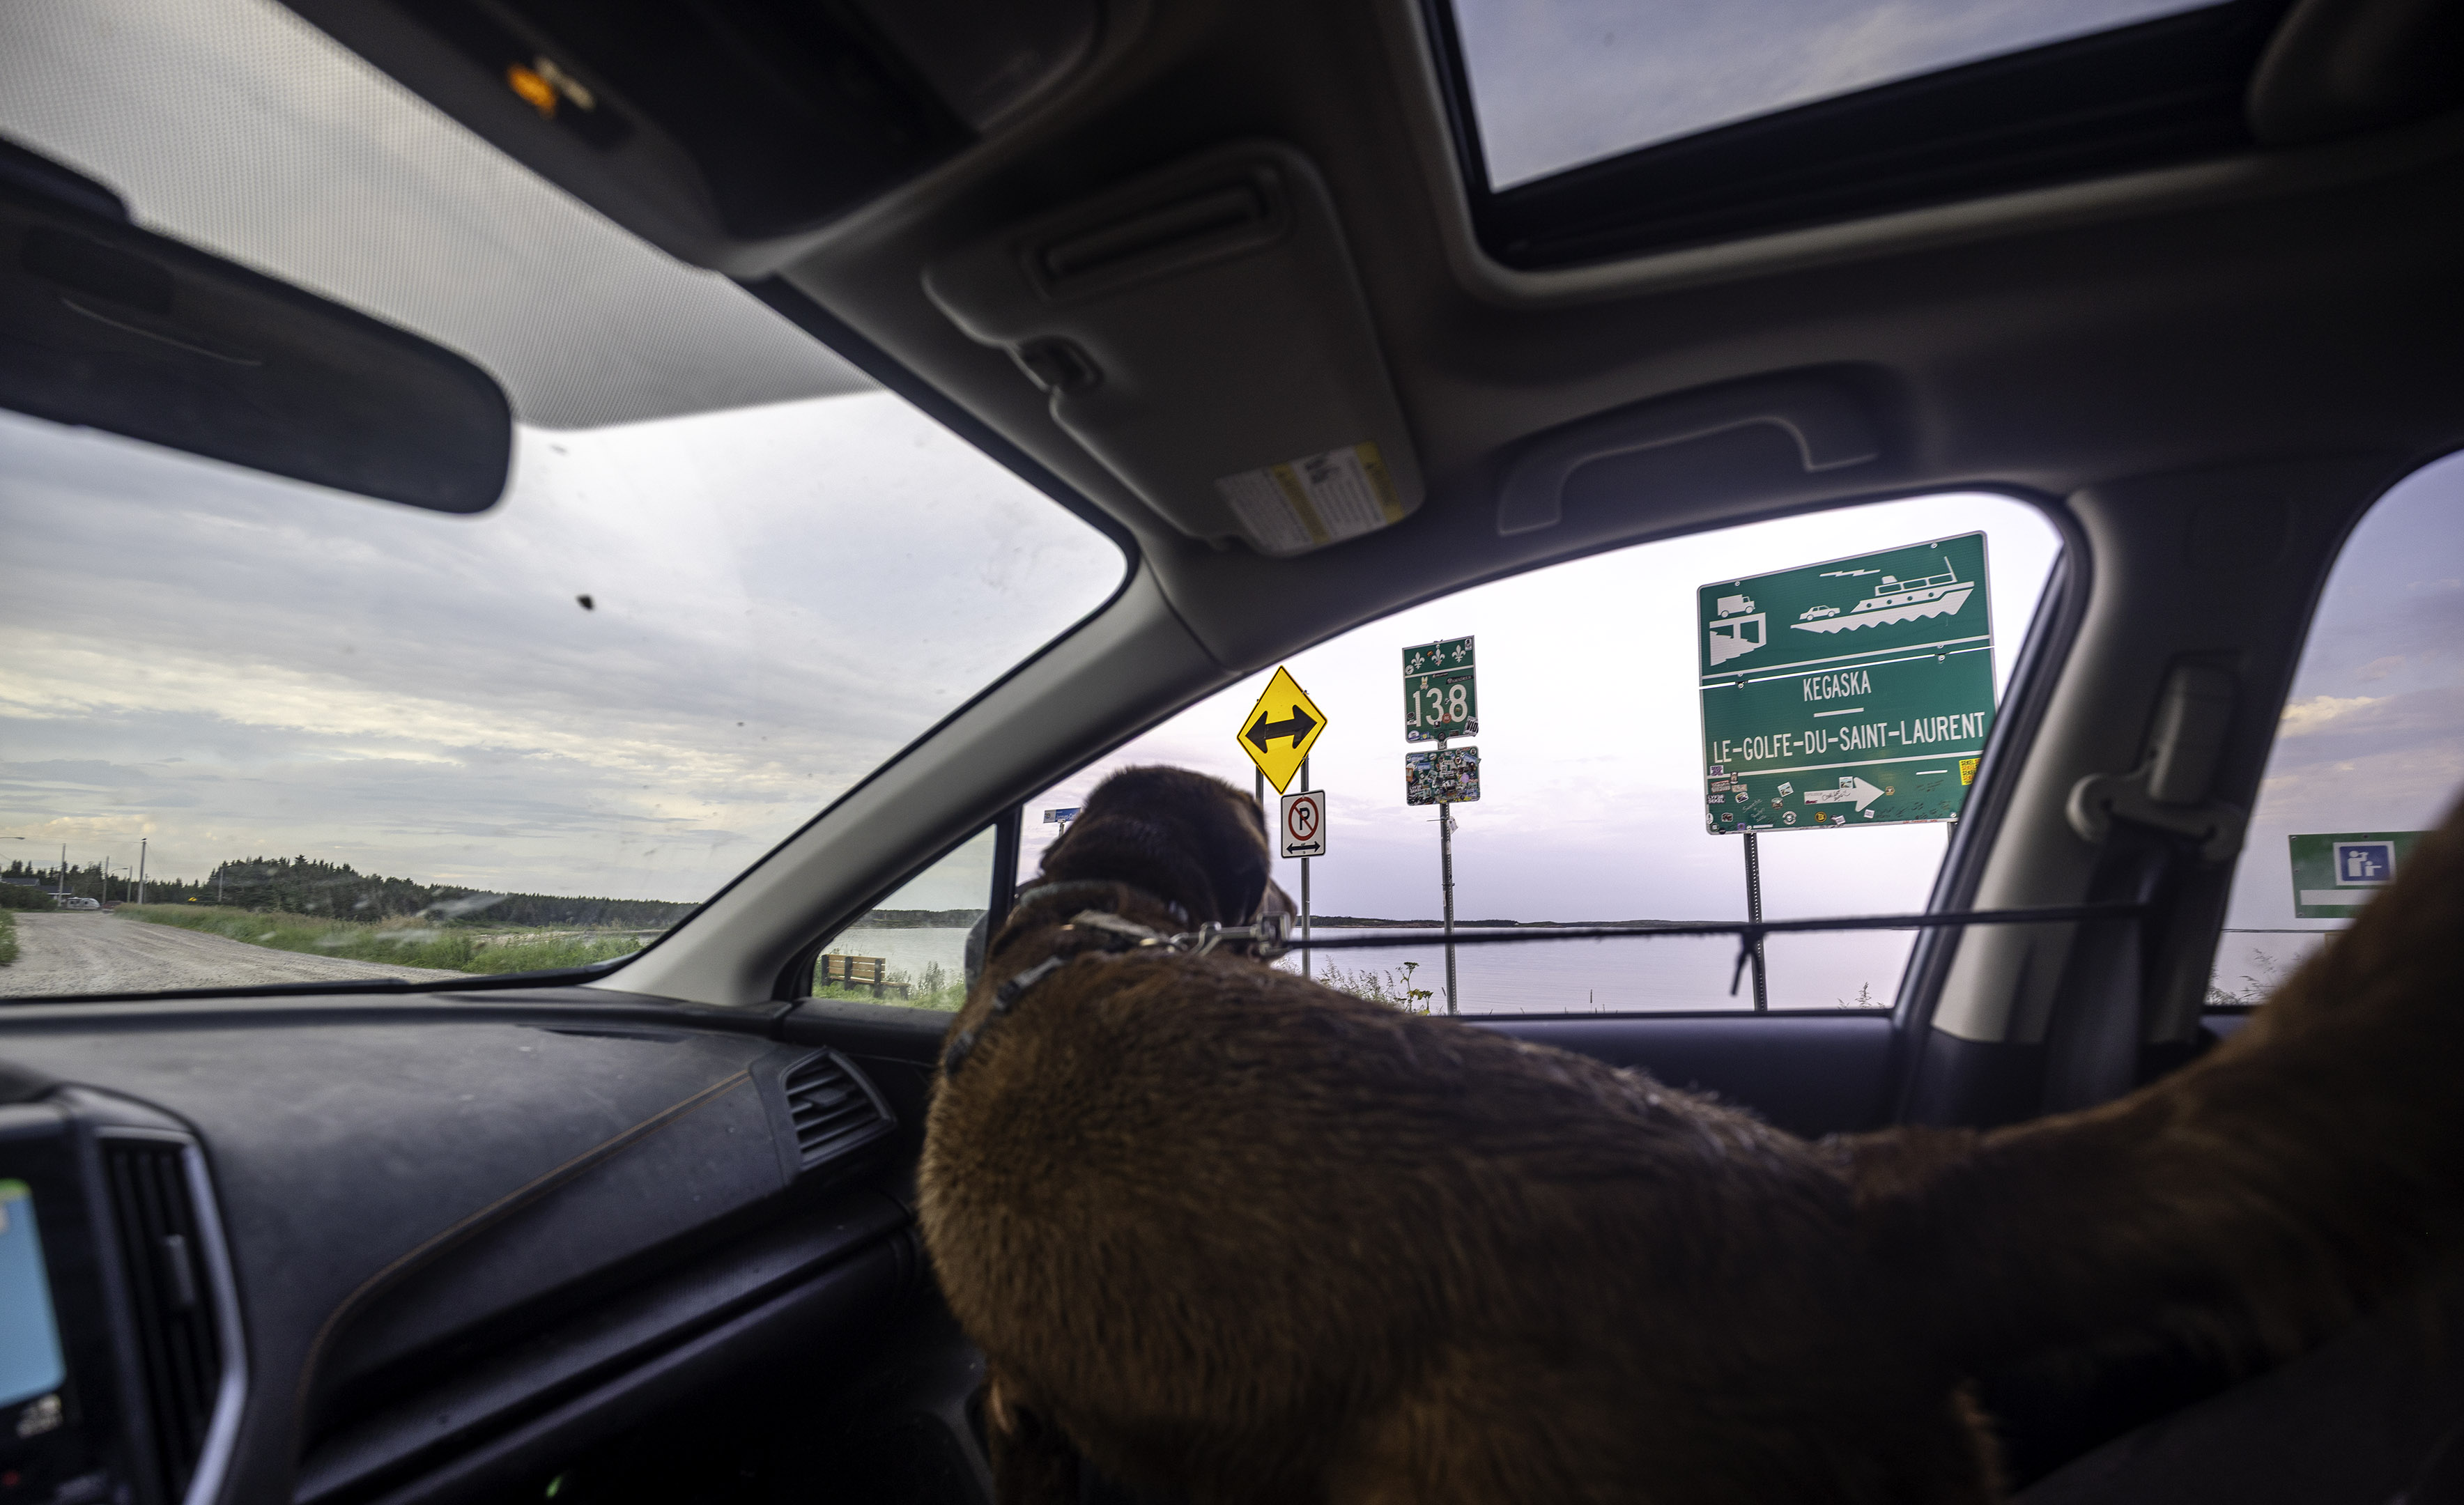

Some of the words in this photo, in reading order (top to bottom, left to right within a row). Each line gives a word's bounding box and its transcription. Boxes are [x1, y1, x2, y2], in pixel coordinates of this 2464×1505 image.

[1412, 684, 1468, 727] 138
[1803, 670, 1872, 702] KEGASKA
[1713, 712, 1985, 764] LE-GOLFE-DU-SAINT-LAURENT
